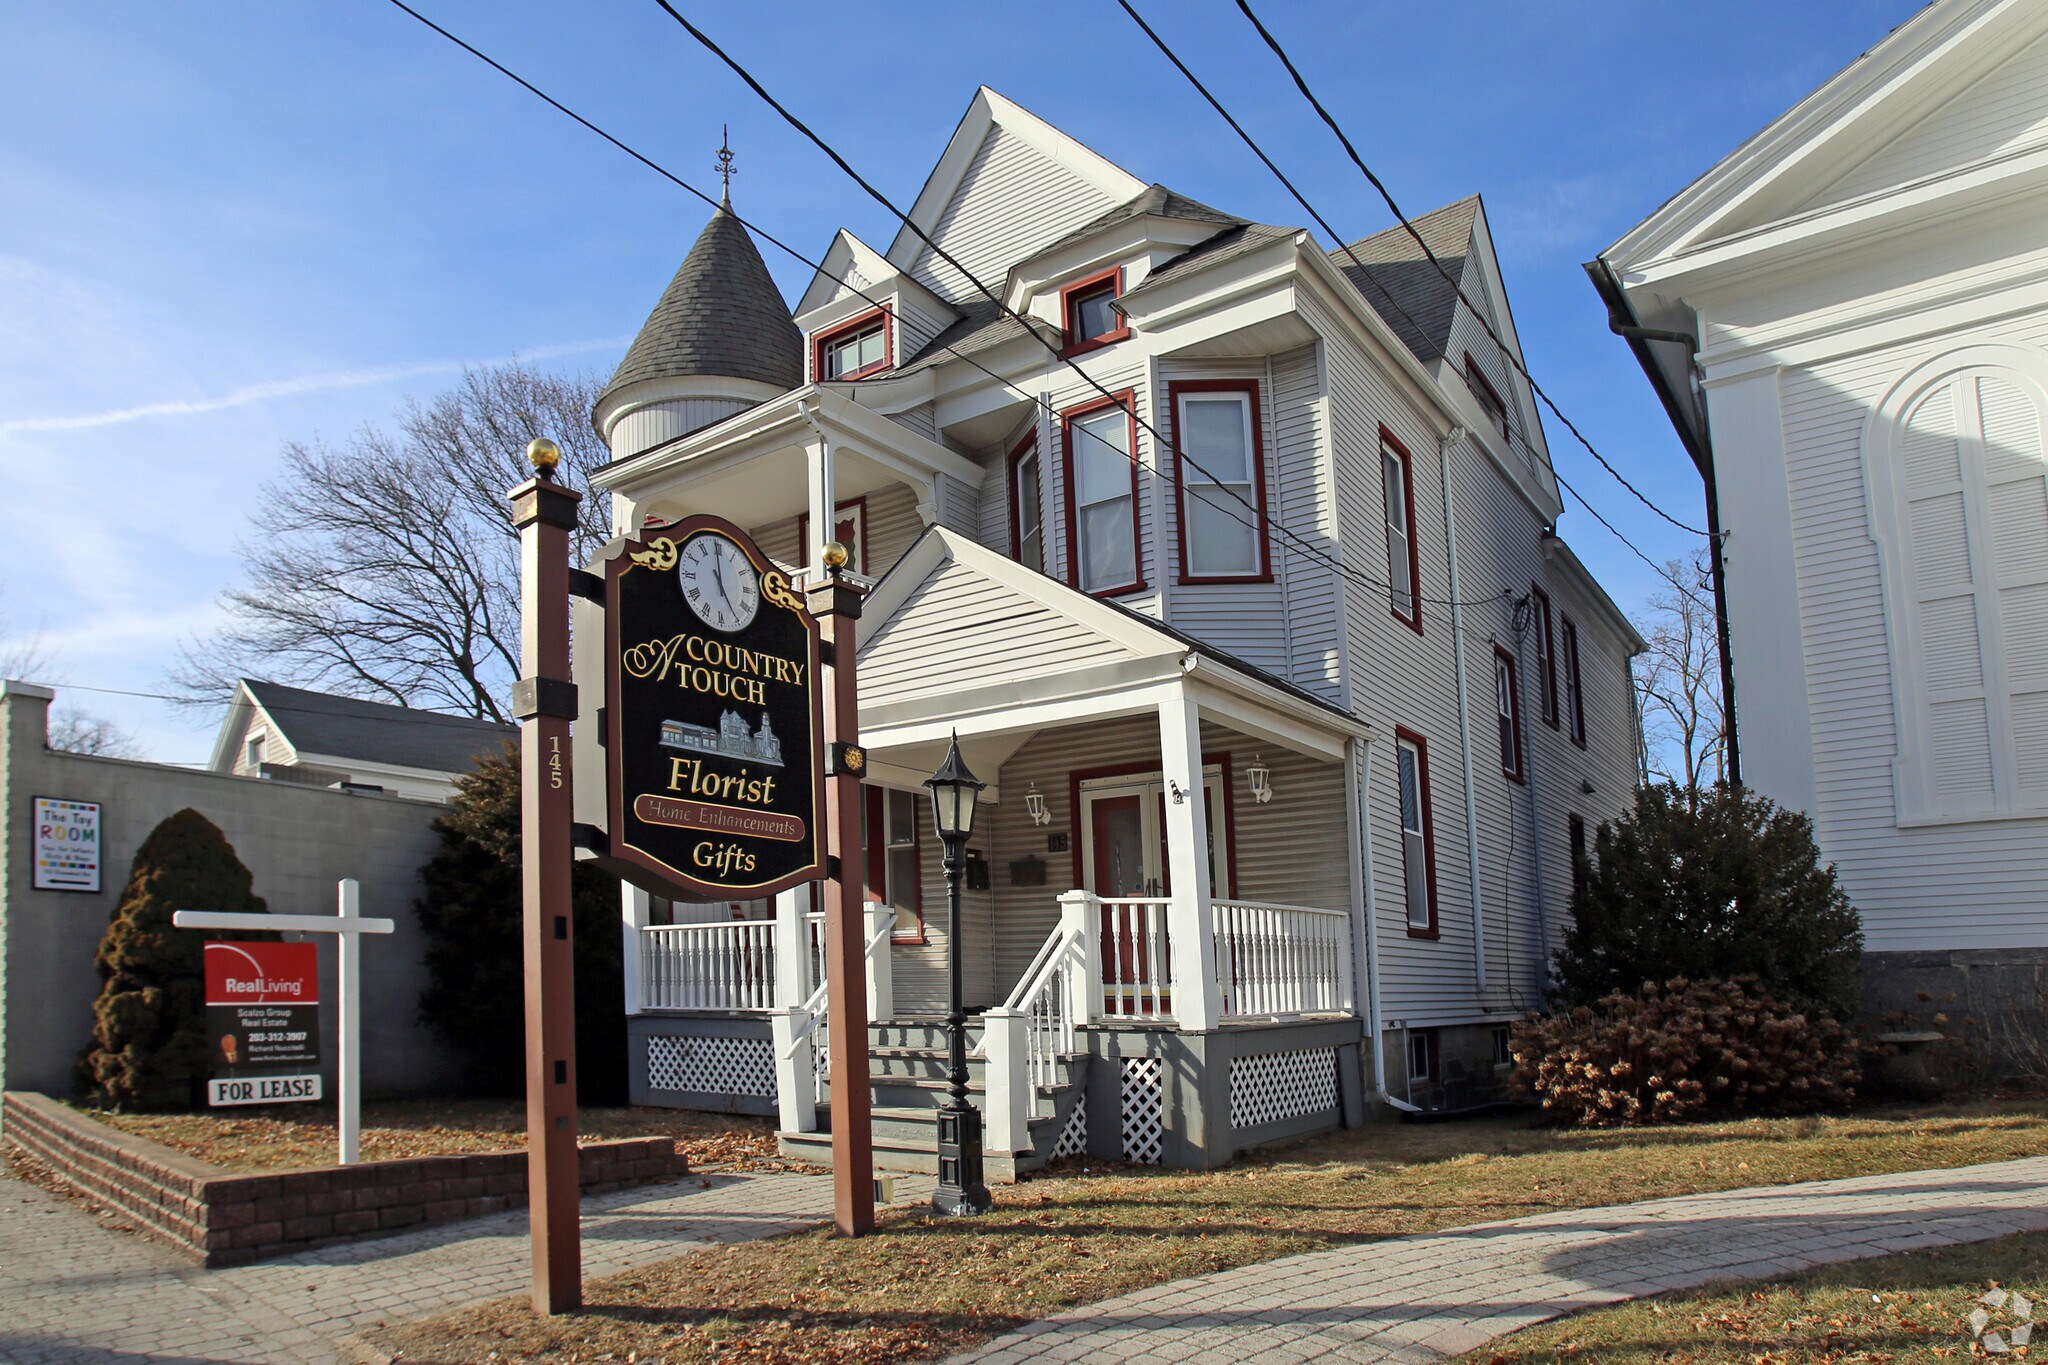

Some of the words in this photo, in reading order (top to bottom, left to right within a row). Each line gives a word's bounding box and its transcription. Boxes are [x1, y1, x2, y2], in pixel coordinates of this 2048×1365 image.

[623, 633, 686, 682] A
[686, 636, 804, 686] COUNTRY
[675, 662, 766, 705] TOUCH
[549, 736, 562, 789] 145
[666, 756, 776, 805] Florist
[41, 825, 95, 843] ROOM
[44, 810, 66, 822] The
[72, 812, 92, 826] Toy
[649, 800, 691, 822] Home
[699, 807, 795, 835] Enhancements
[693, 841, 756, 878] Gifts
[237, 1008, 265, 1017] Scalzo
[266, 1008, 292, 1018] Group
[242, 1019, 260, 1027] Real
[262, 1018, 288, 1027] Estate
[217, 1082, 253, 1101] FOR
[260, 1079, 314, 1099] LEASE
